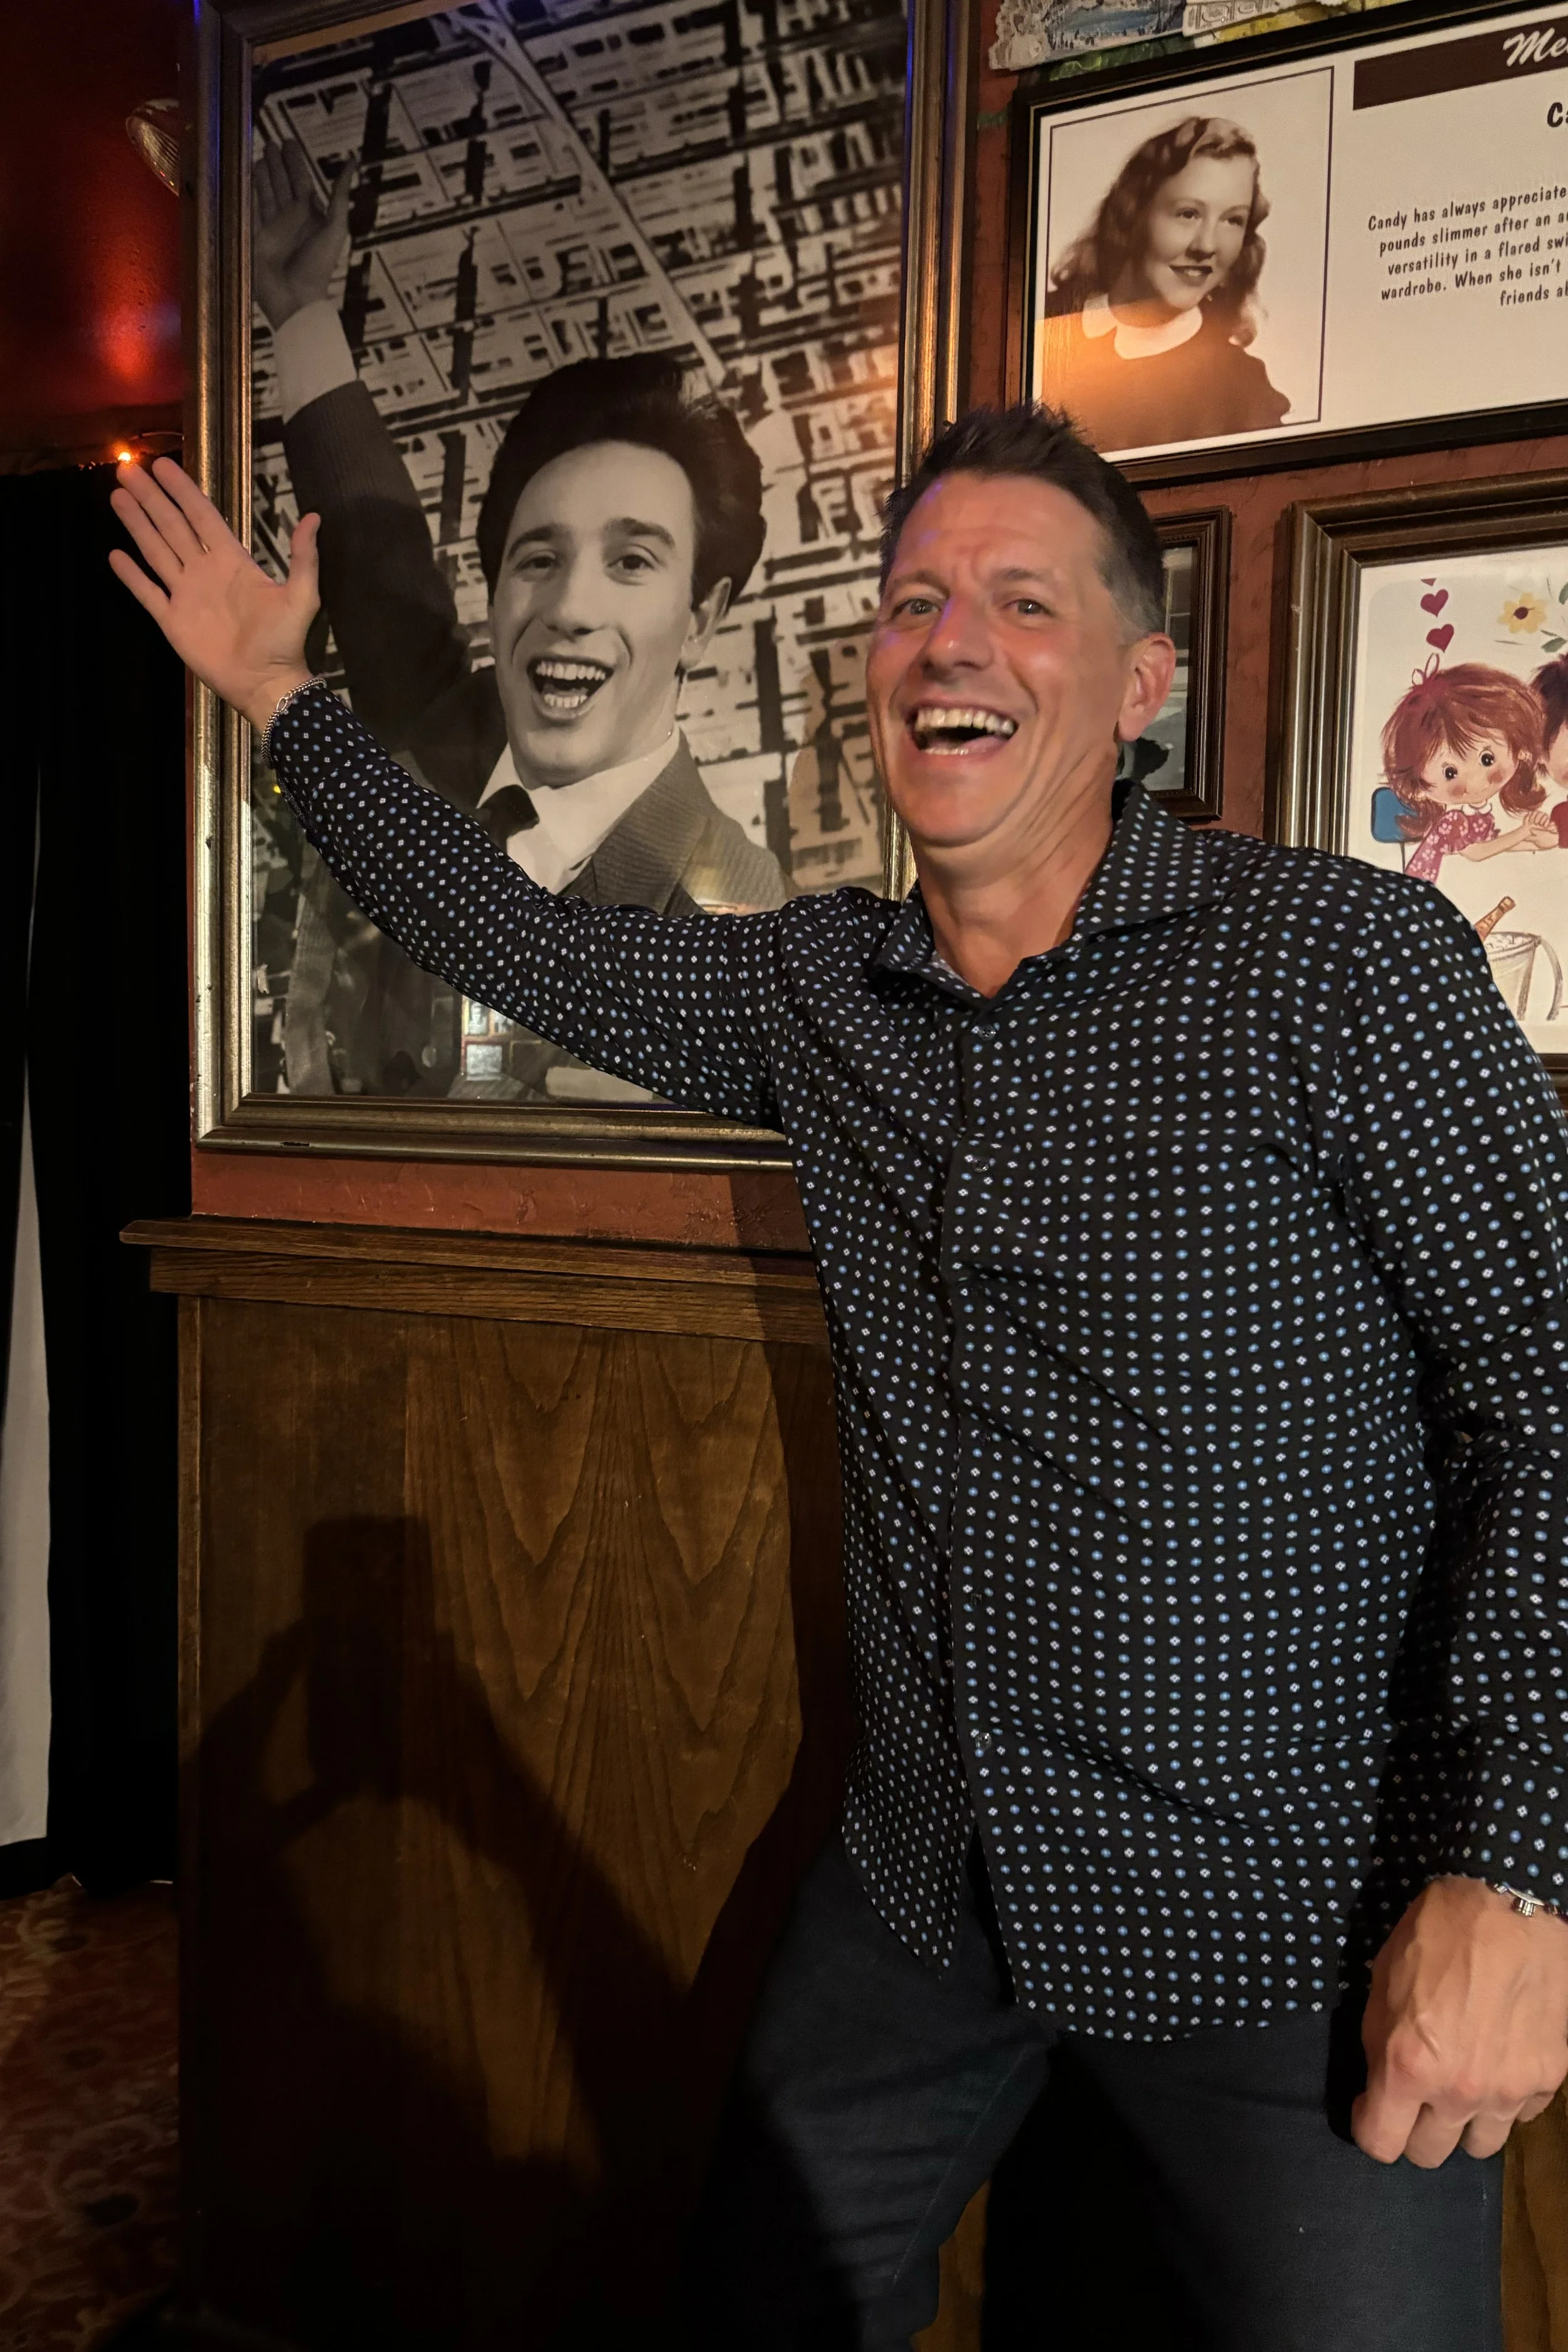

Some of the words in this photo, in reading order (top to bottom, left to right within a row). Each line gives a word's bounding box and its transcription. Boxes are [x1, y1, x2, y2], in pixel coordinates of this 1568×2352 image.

[1503, 28, 1568, 67] Me
[1547, 102, 1568, 128] C
[1368, 210, 1407, 231] Candy
[1414, 207, 1436, 223] has
[1441, 201, 1486, 218] always
[1492, 185, 1567, 213] appreciate
[1379, 231, 1426, 258] pounds
[1431, 225, 1488, 244] slimmer
[1493, 216, 1529, 234] after
[1535, 215, 1551, 227] an
[1557, 212, 1568, 224] a
[1387, 251, 1459, 275] versatility
[1465, 248, 1478, 263] in
[1484, 248, 1491, 260] a
[1498, 235, 1540, 258] flared
[1381, 277, 1447, 300] wardrobe.
[1454, 270, 1493, 289] When
[1499, 263, 1522, 282] she
[1529, 257, 1561, 277] isn't
[1500, 284, 1550, 307] friends
